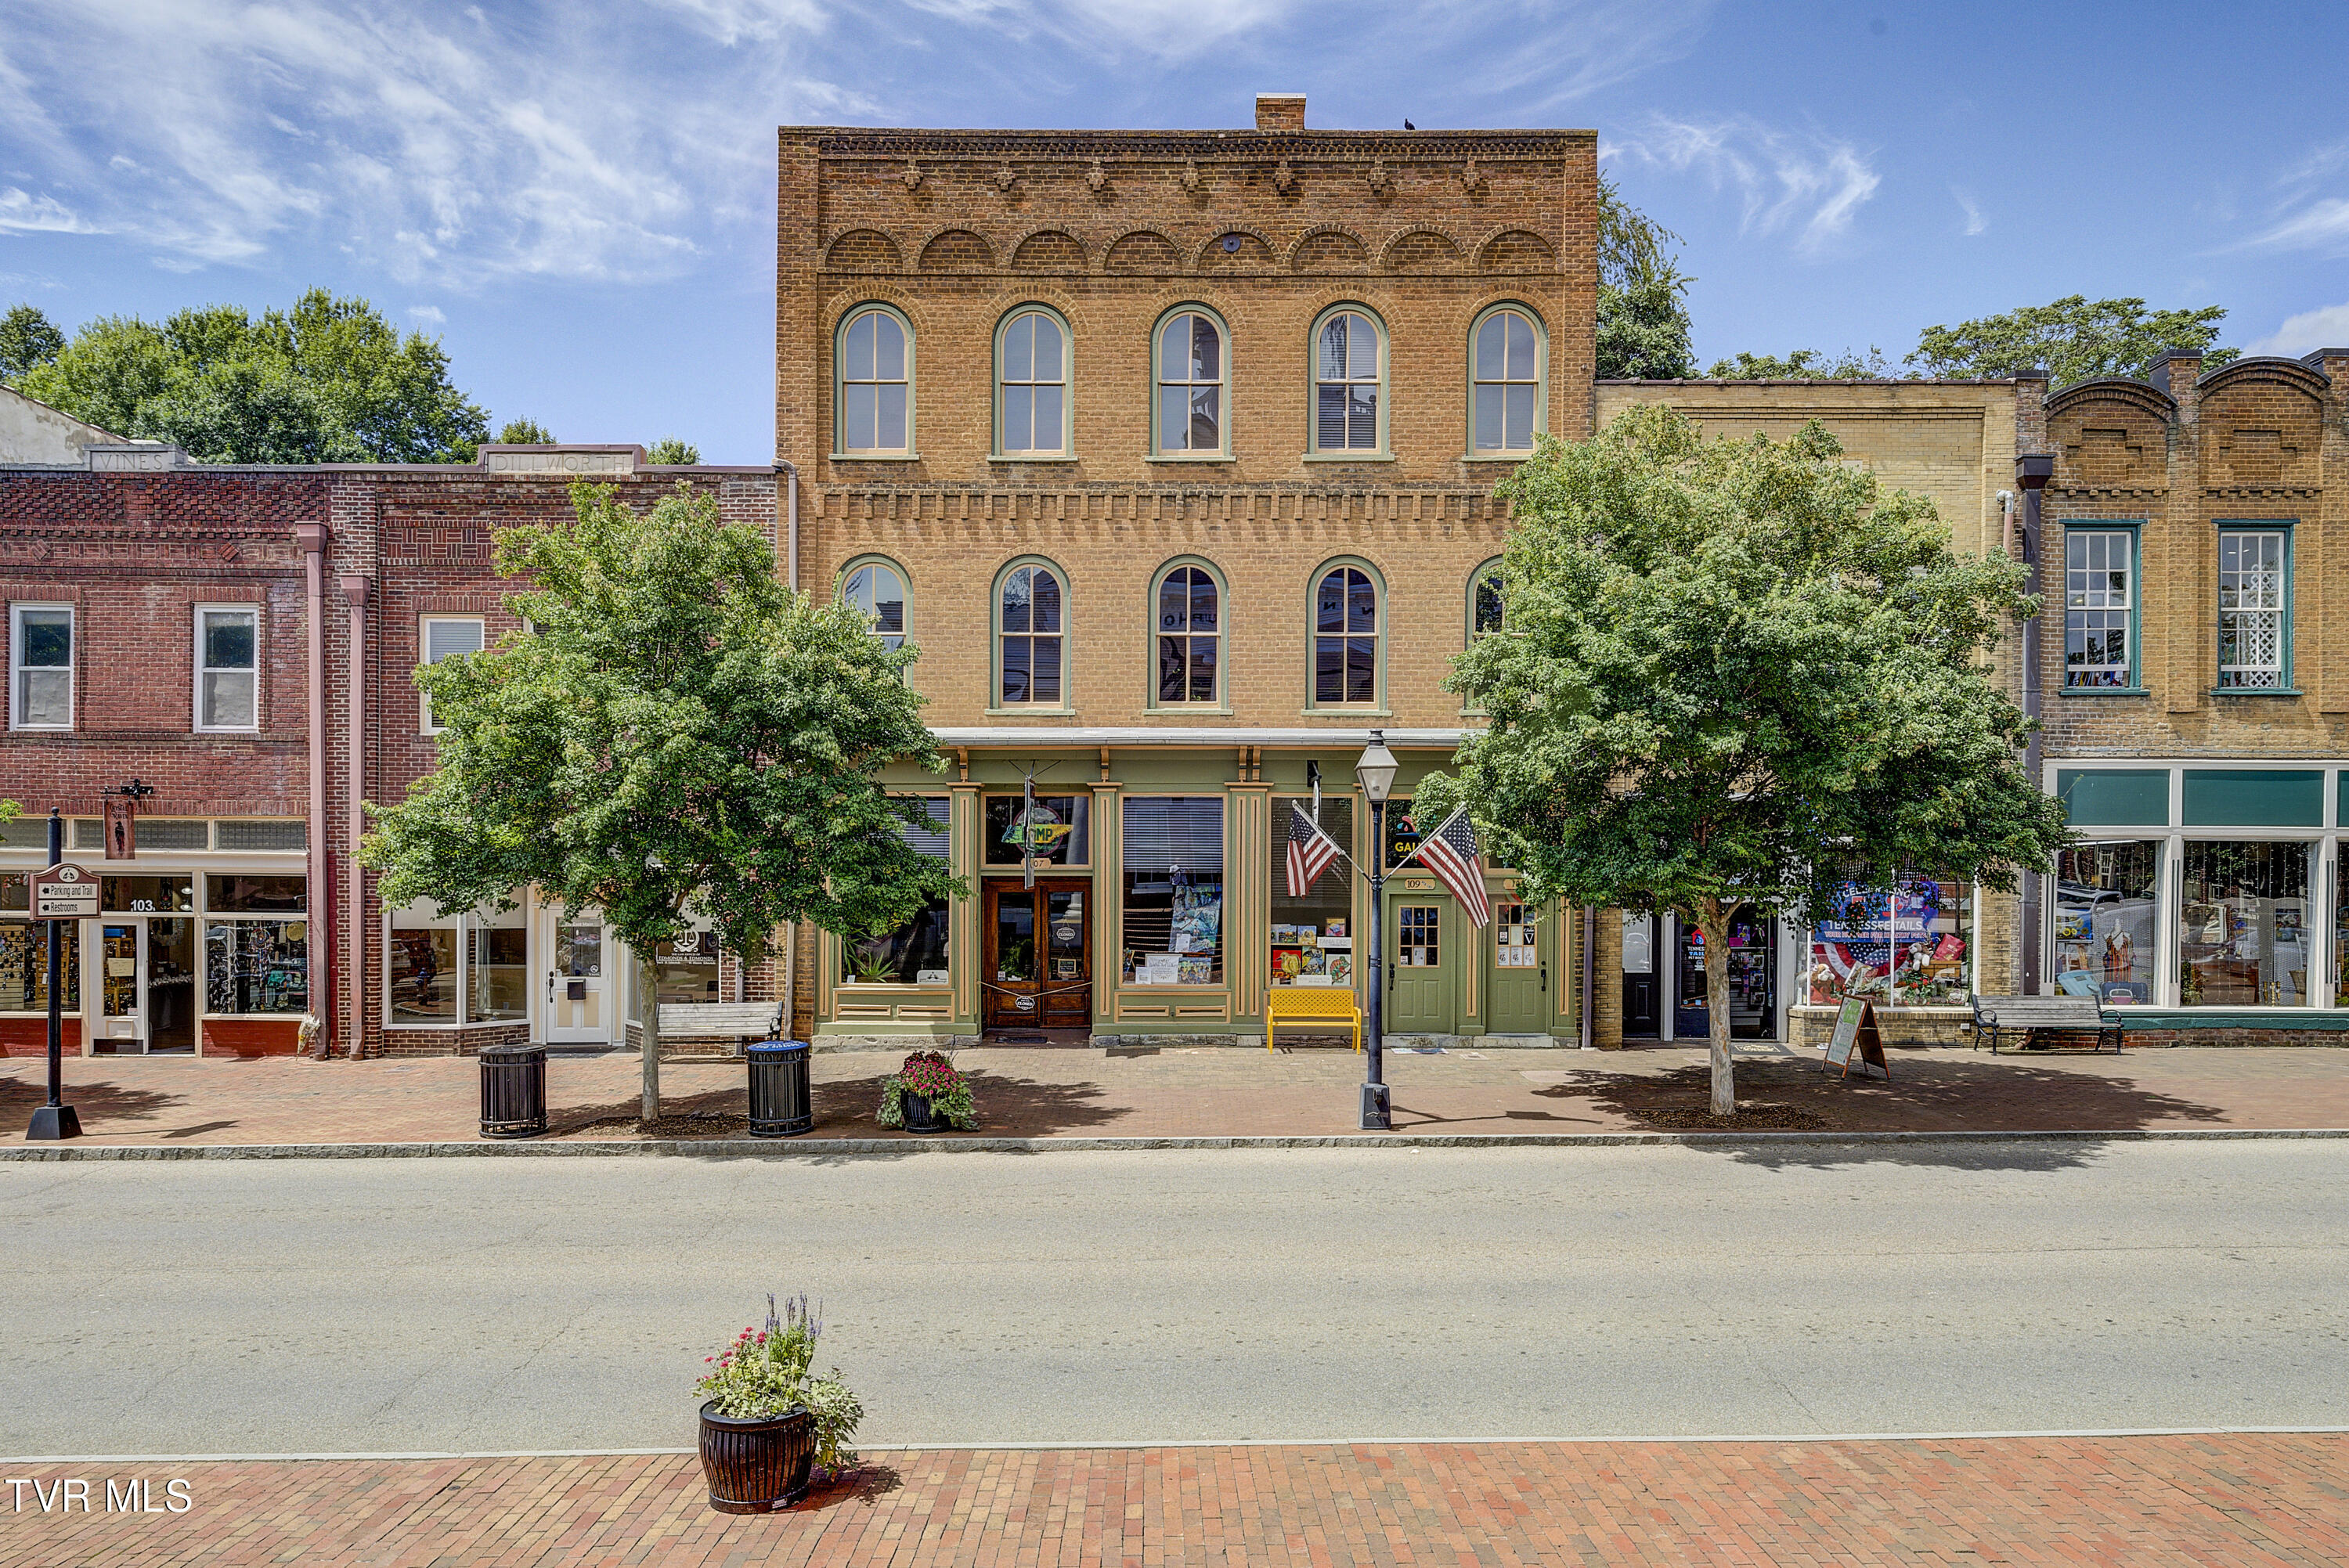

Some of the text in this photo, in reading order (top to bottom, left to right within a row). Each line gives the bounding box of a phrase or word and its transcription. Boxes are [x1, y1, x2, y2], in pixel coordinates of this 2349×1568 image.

[100, 454, 163, 470] VINES
[495, 456, 626, 471] DILLWORTH
[50, 885, 92, 897] Parking and Trail
[50, 902, 78, 913] Restrooms
[131, 899, 153, 911] 103
[1894, 921, 1923, 931] TAILS
